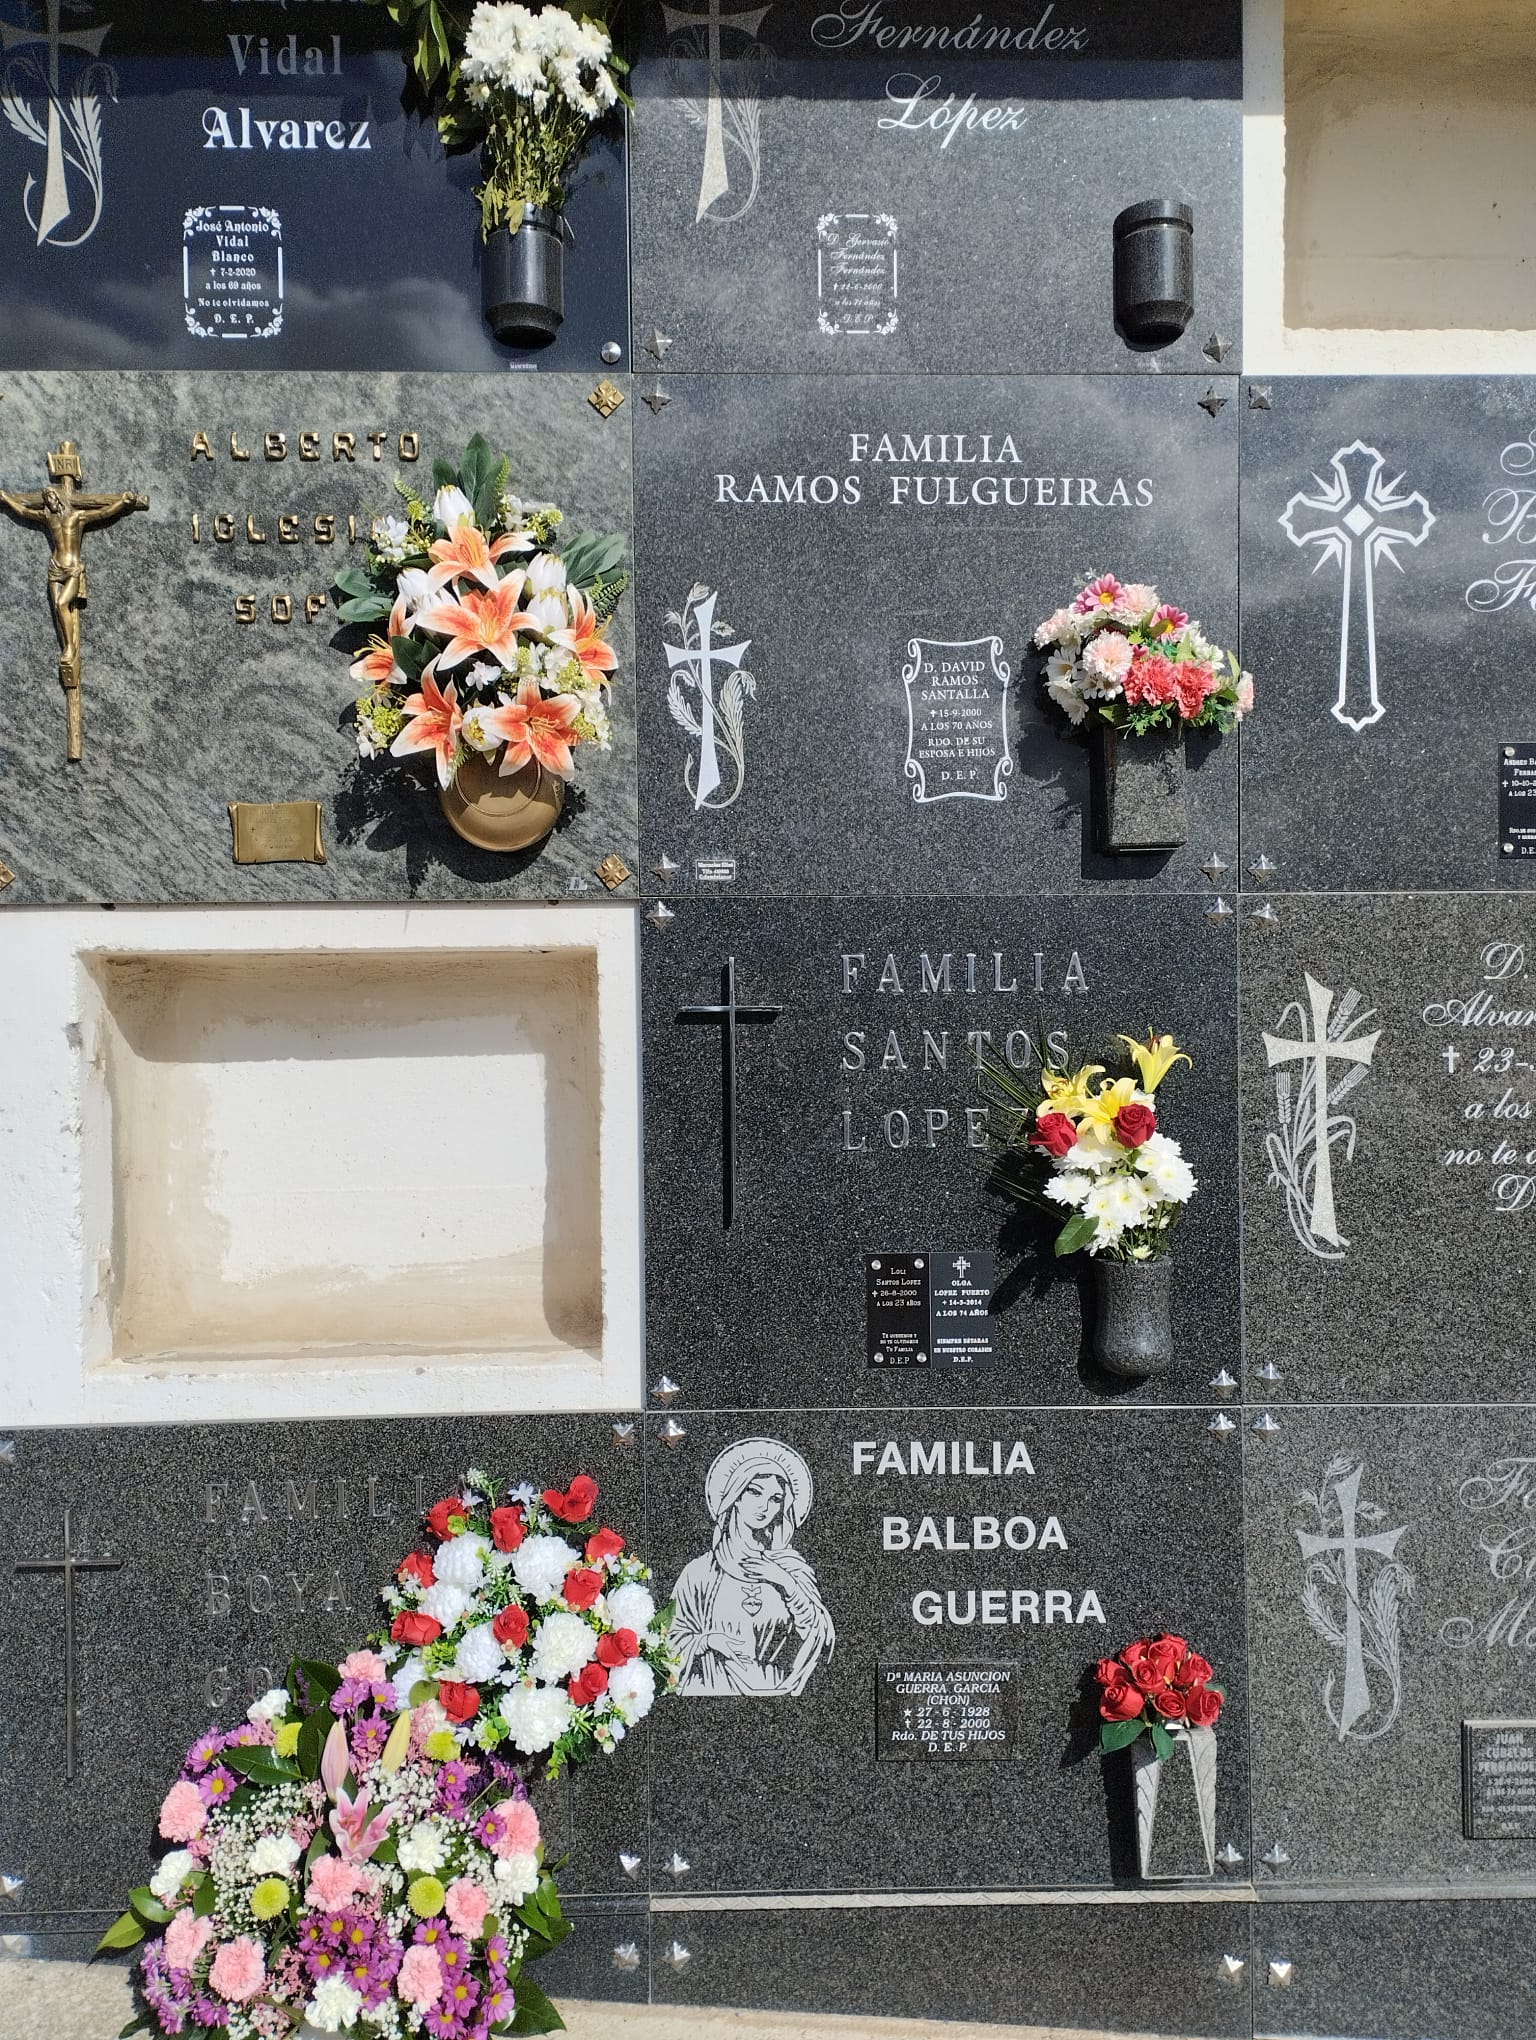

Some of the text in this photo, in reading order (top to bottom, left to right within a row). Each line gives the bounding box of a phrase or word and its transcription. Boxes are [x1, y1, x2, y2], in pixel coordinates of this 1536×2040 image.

[810, 0, 1090, 50] Fernández
[226, 34, 345, 77] Vidal
[877, 72, 1028, 149] López
[202, 106, 372, 150] Alvarez
[195, 219, 270, 233] José Antonio
[216, 235, 249, 247] Vidal
[211, 250, 255, 263] Blanco
[220, 267, 256, 277] 7-2-2020
[213, 281, 226, 290] los
[240, 281, 262, 291] años
[198, 298, 270, 308] No te olvidamos
[190, 431, 420, 462] ALBERTO
[848, 433, 1022, 463] FAMILIA
[714, 473, 1154, 508] RAMOS FULGUEIRAS
[234, 594, 345, 625] SOF
[924, 661, 985, 673] D. DAVID
[931, 675, 979, 687] RAMOS
[921, 688, 990, 701] SANTALLA
[921, 719, 993, 731] A LOS 70 AÑOS
[956, 737, 970, 746] DE
[972, 736, 985, 746] SU
[918, 748, 996, 759] ESPOSA E HIJOS
[840, 951, 1090, 994] FAMILIA
[841, 1029, 1069, 1071] SANTOS
[1464, 1088, 1533, 1120] a los
[1444, 1149, 1484, 1167] no
[1491, 1141, 1515, 1167] te
[934, 1289, 990, 1297] LOPEZ PUERTO
[852, 1441, 1036, 1475] FAMILIA
[882, 1515, 1069, 1551] BALBOA
[206, 1570, 352, 1615] BOYA
[911, 1589, 1107, 1626] GUERRA
[903, 1671, 943, 1682] MARIA
[946, 1671, 1011, 1682] ASUNCION
[896, 1683, 1001, 1694] GUERRA GARCIA
[927, 1695, 970, 1706] (CHON)
[961, 1707, 990, 1717] 1928
[960, 1718, 991, 1729] 2000
[891, 1730, 1006, 1741] Rdo. DE TUS HIJOS
